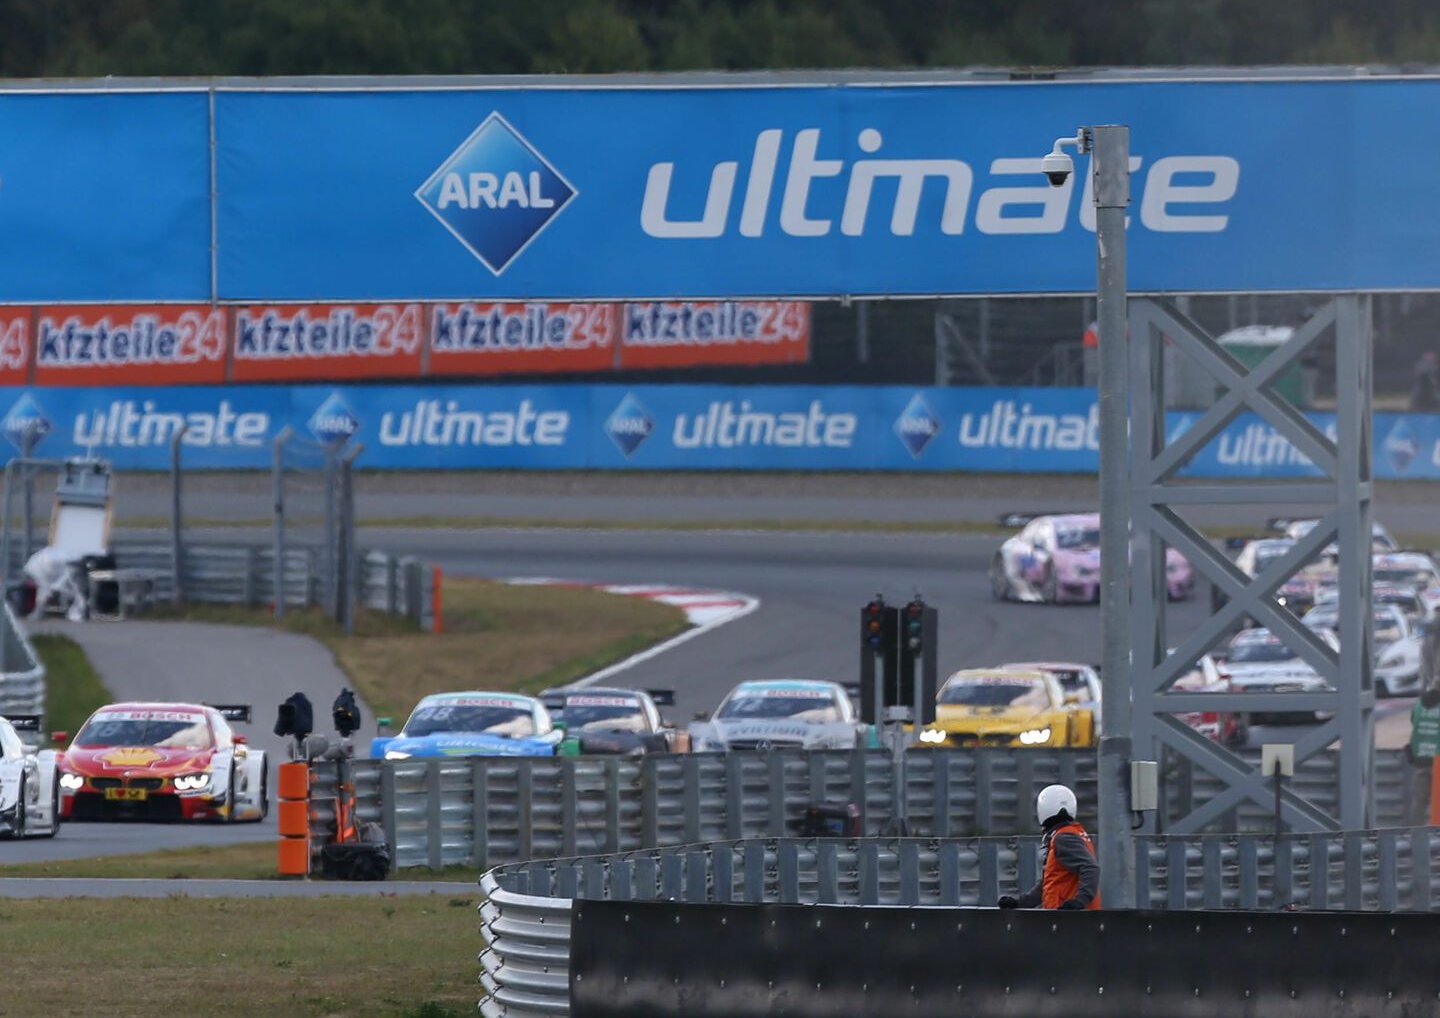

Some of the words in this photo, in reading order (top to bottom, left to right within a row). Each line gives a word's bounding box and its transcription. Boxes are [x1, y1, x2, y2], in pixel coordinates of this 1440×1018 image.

[436, 170, 556, 210] ARAL
[37, 311, 227, 368] kfzteile24
[235, 305, 422, 360] kfzteile24
[430, 303, 616, 352] kfzteile24
[73, 399, 270, 447] ultimate
[379, 399, 570, 447] ultimate
[673, 400, 857, 448] ultimate
[130, 711, 192, 721] BOSCH
